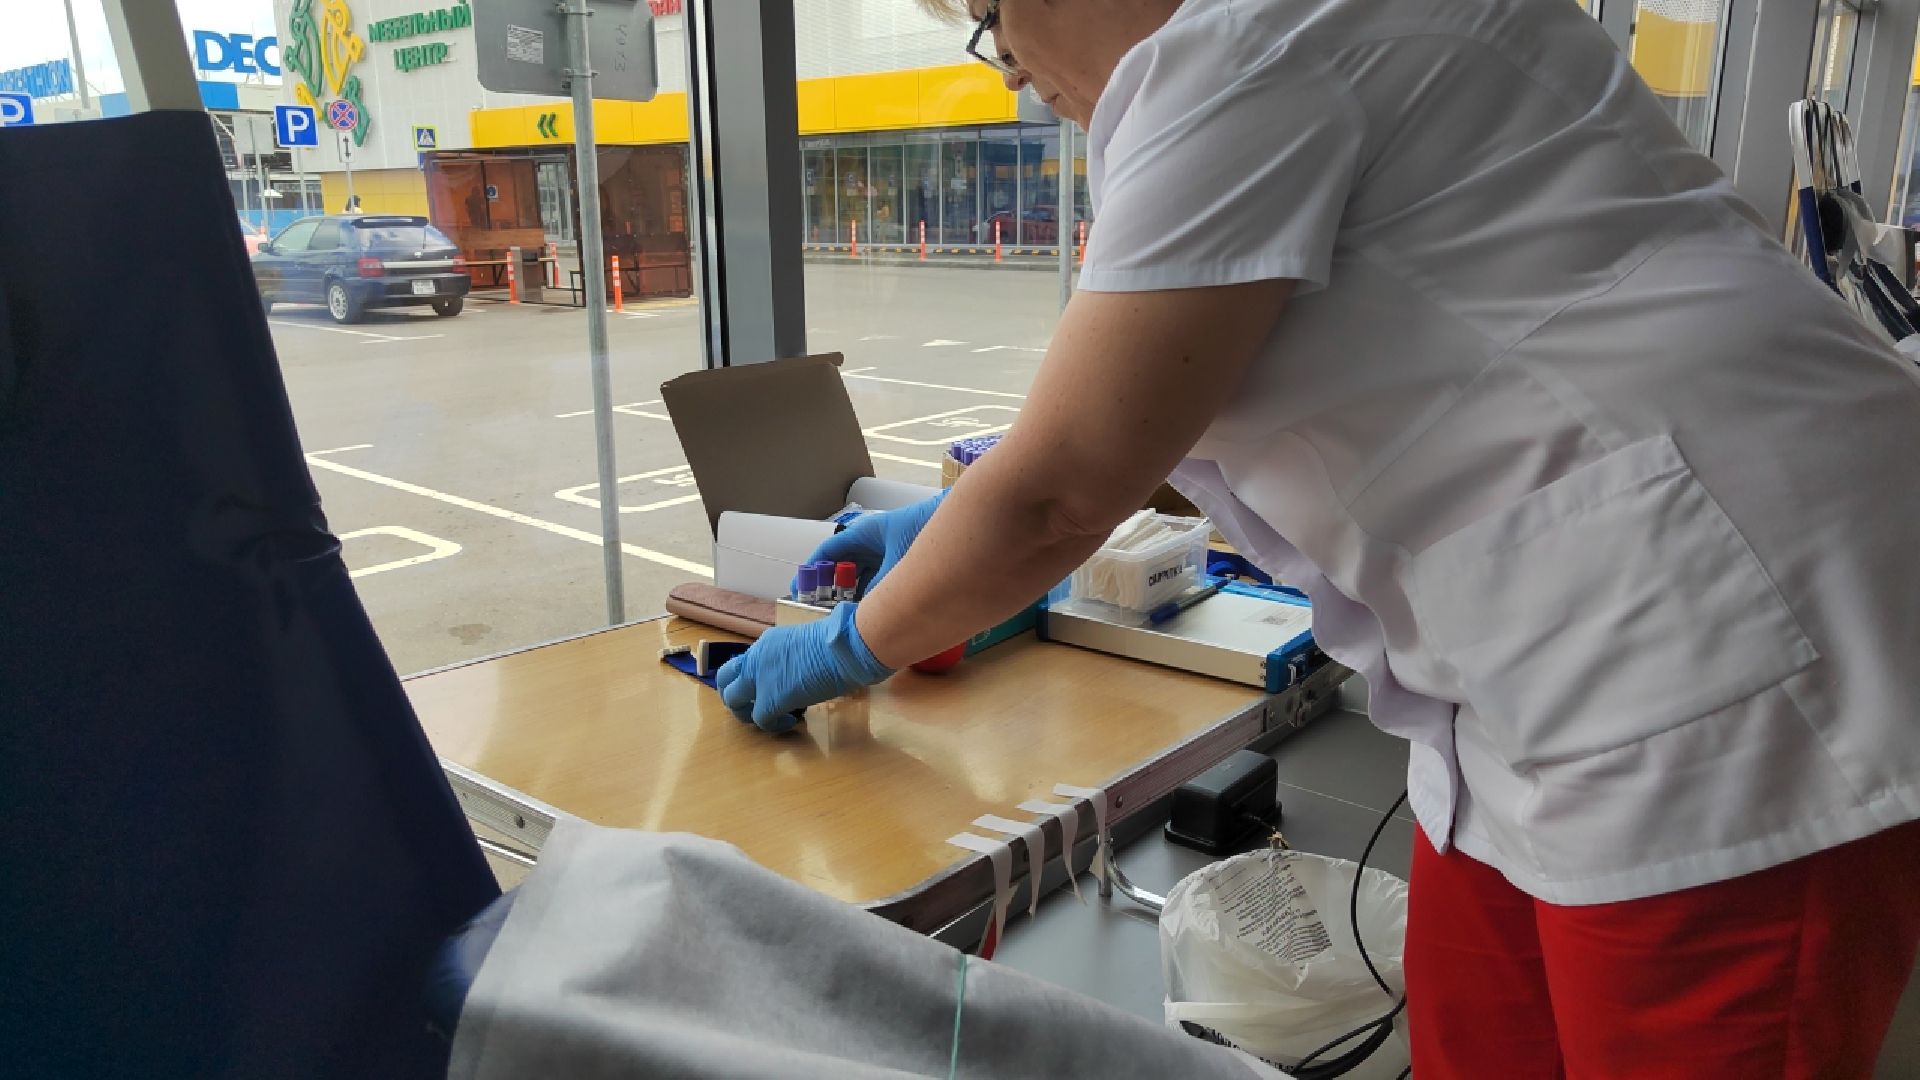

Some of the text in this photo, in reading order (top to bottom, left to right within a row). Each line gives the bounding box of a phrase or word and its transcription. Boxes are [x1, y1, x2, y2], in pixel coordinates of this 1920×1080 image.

[368, 0, 471, 43] МЕБЕЛЬНЫЙ
[193, 30, 280, 76] DEC
[394, 42, 448, 72] ЦЕНТР
[286, 109, 309, 142] P
